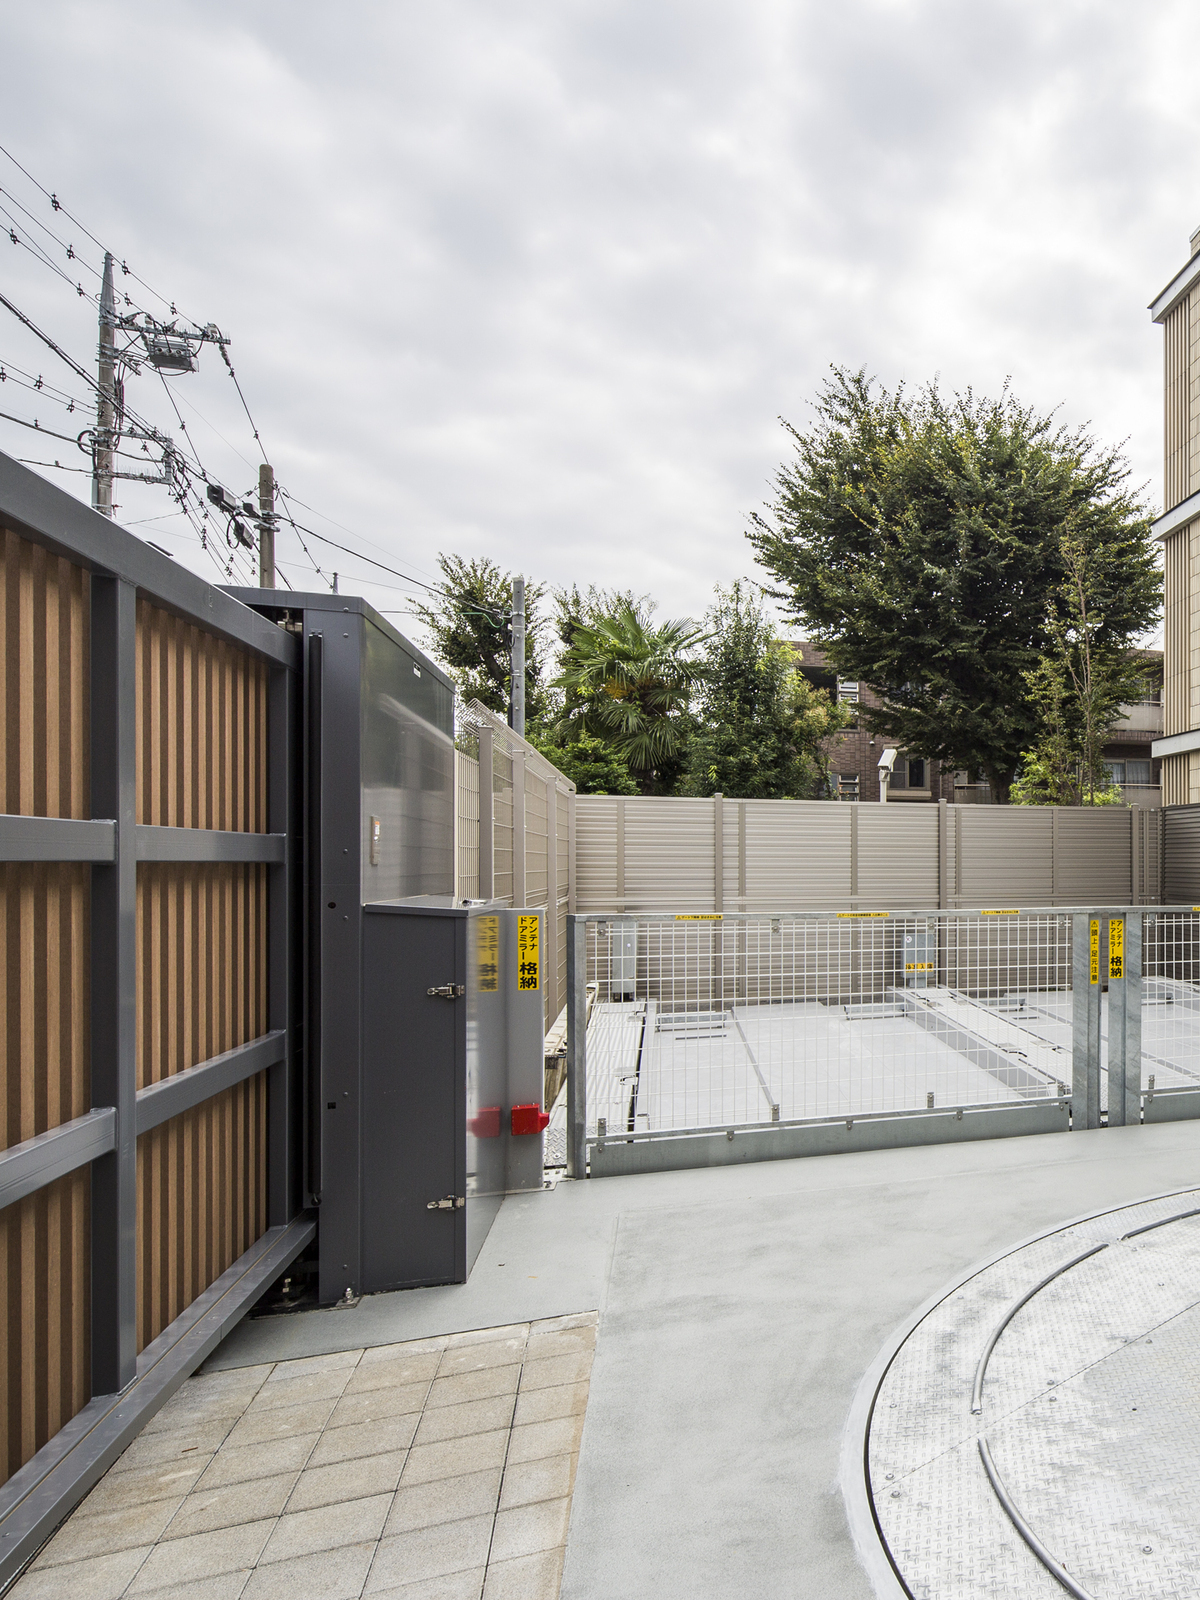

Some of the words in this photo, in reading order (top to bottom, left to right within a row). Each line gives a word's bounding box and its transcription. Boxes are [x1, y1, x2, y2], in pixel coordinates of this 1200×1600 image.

[518, 916, 528, 960] ドアミラー
[528, 916, 538, 951] アンテナ
[519, 961, 538, 989] 格納
[1110, 956, 1122, 977] 格納
